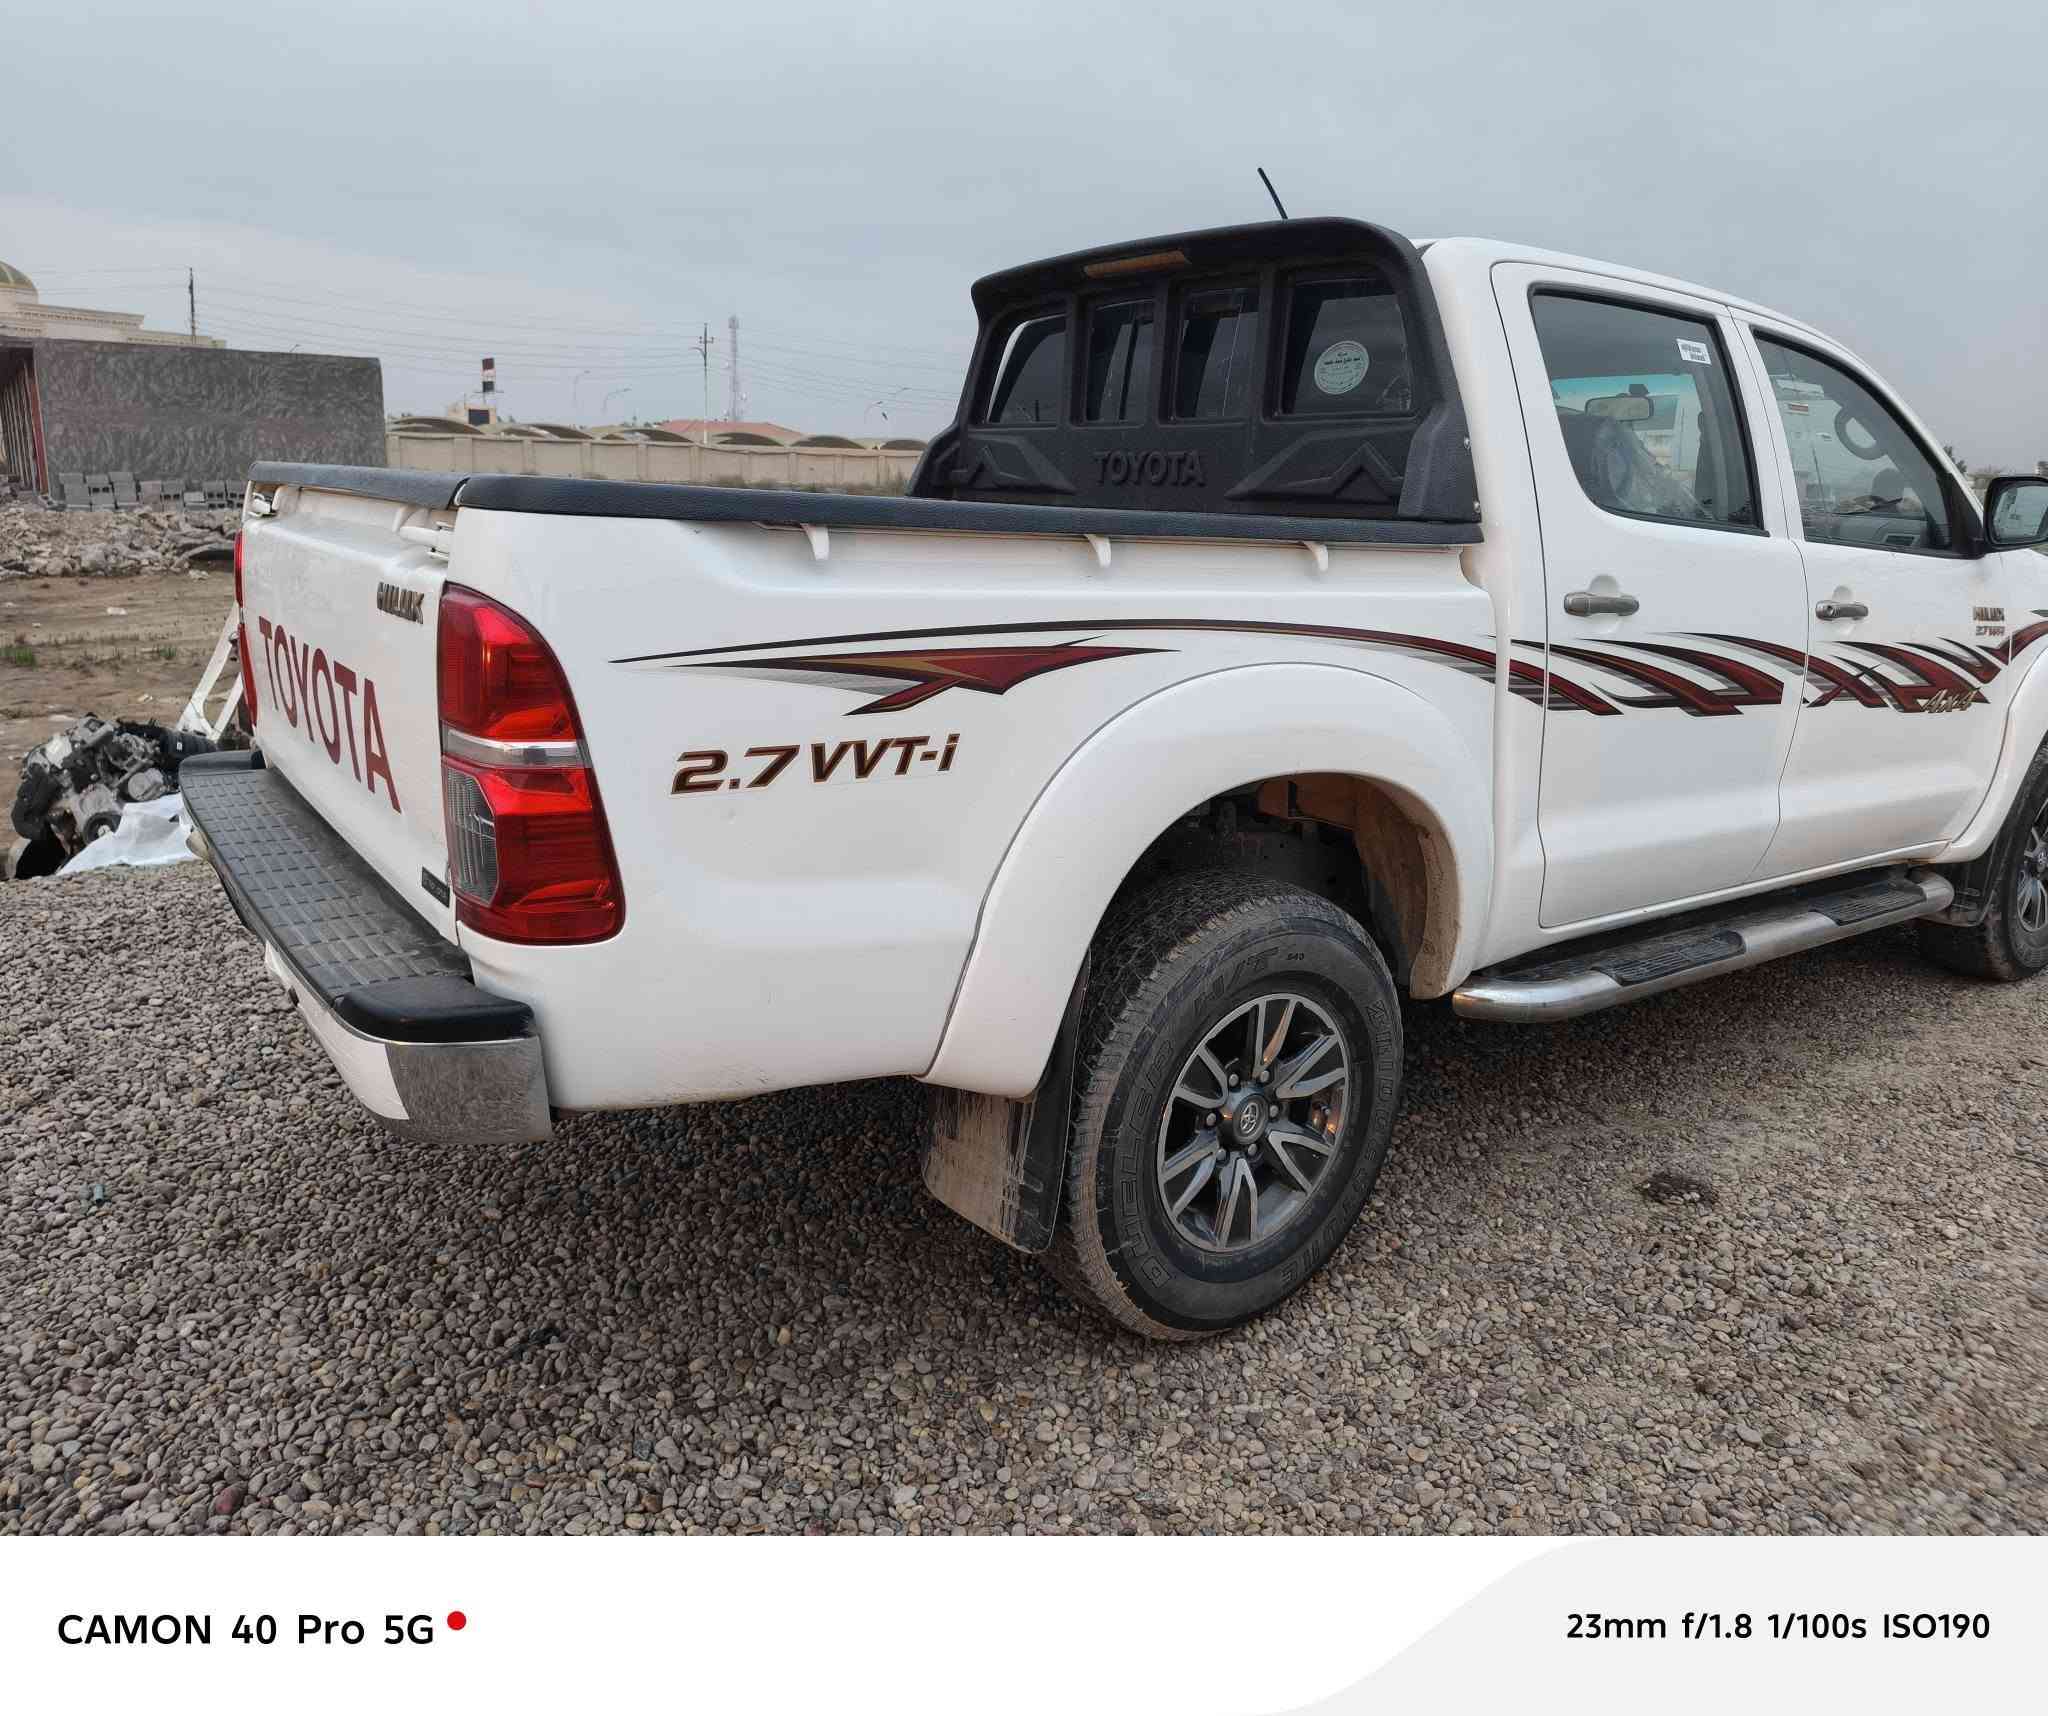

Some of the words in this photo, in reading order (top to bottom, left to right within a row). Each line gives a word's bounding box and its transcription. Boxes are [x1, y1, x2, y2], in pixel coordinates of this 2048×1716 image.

[1092, 449, 1207, 488] TOYOTA
[377, 581, 425, 625] HILUX
[258, 615, 402, 815] TOYOTA
